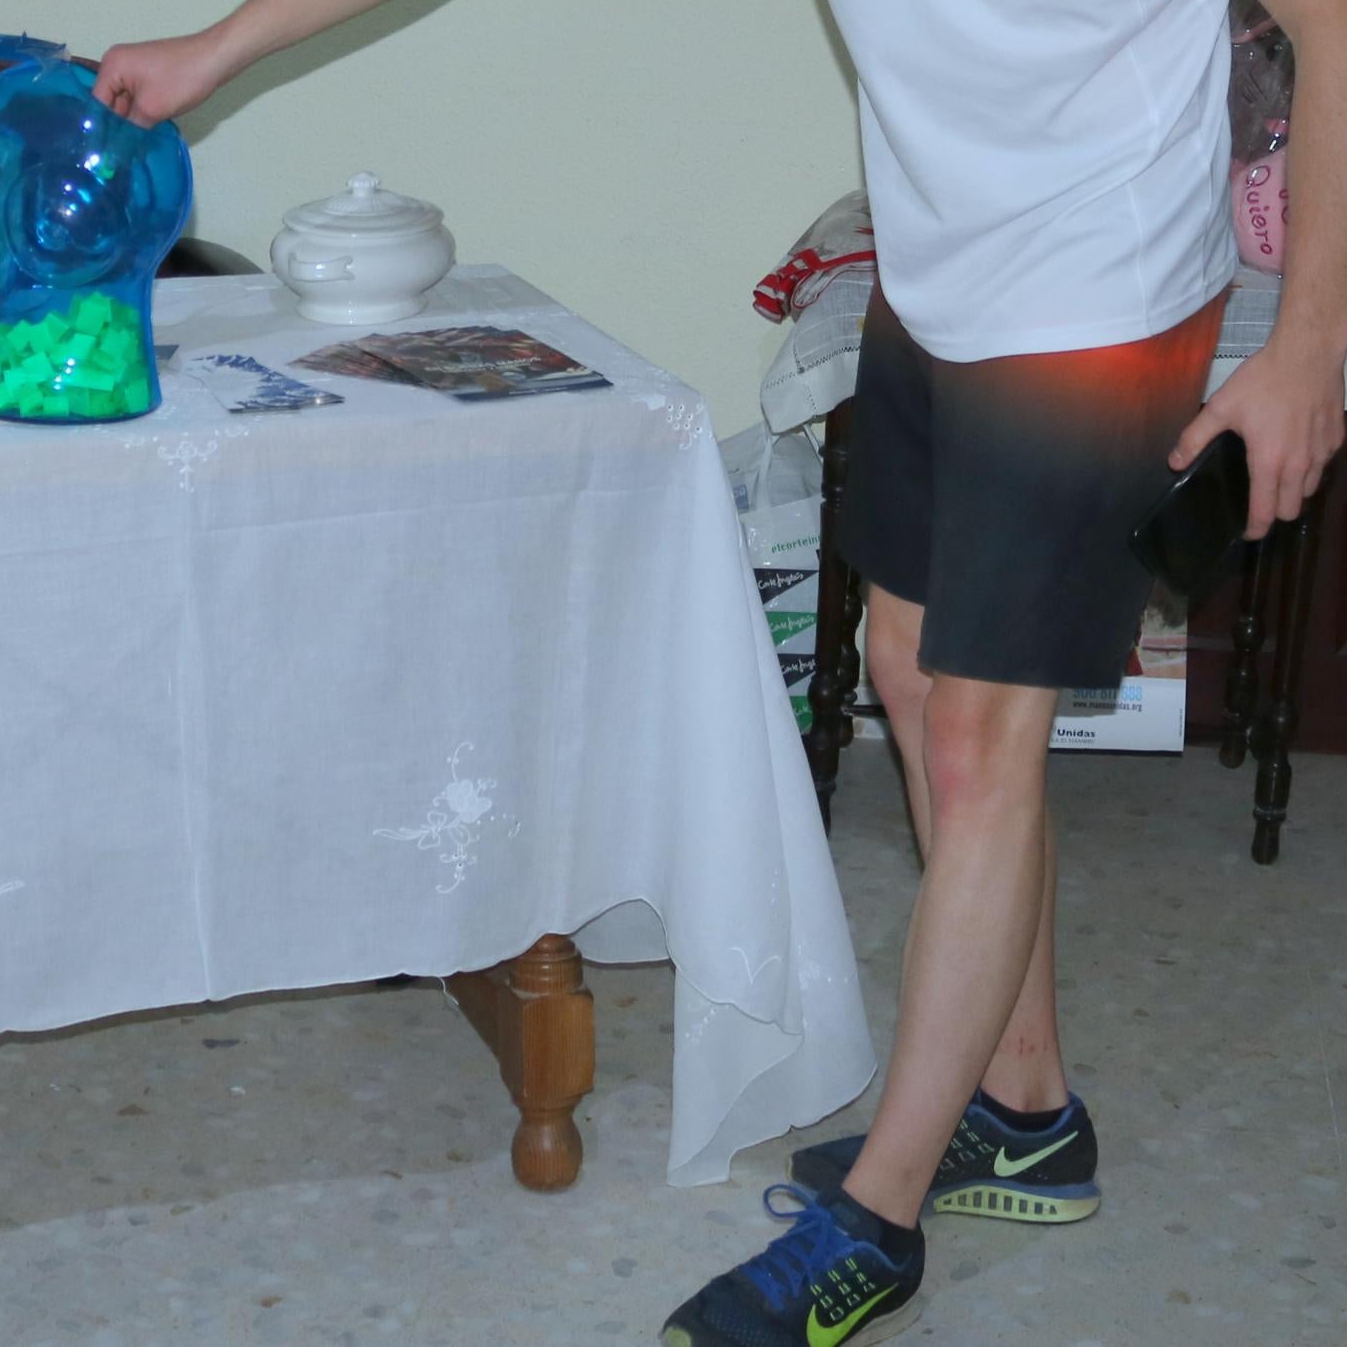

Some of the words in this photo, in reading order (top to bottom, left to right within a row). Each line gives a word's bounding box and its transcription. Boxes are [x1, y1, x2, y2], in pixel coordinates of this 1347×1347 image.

[1245, 165, 1273, 255] Quiero
[1121, 685, 1143, 701] 888
[1057, 728, 1096, 738] Unidas
